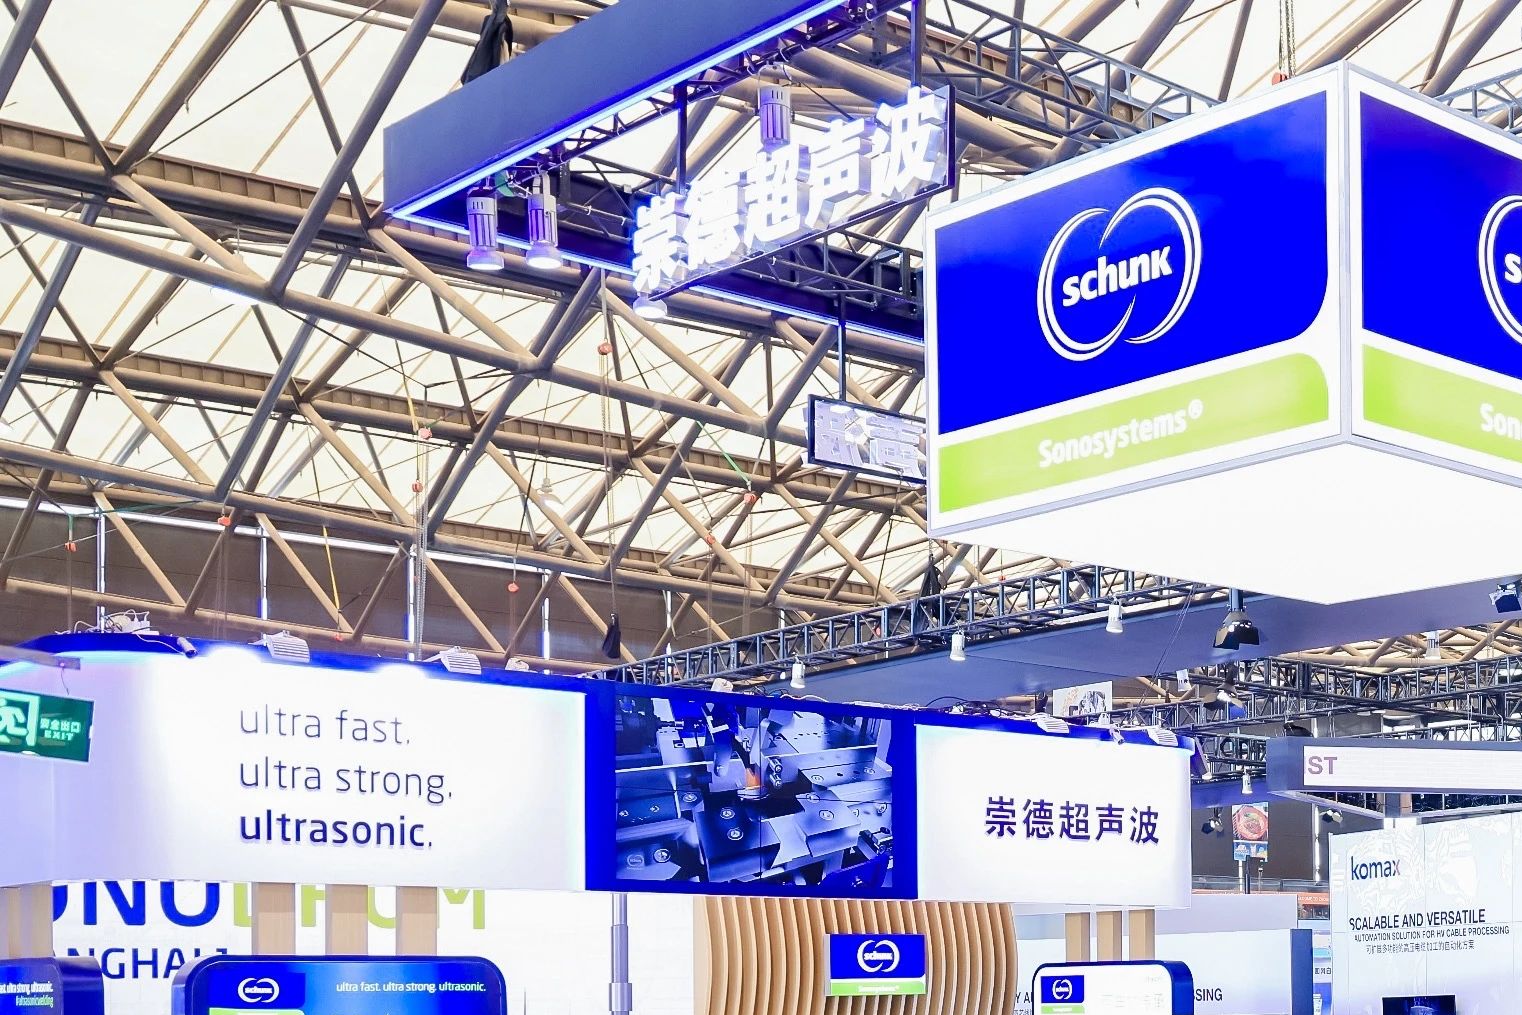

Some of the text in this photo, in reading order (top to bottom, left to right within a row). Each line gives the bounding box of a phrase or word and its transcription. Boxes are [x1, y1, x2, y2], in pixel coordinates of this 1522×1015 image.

[633, 88, 947, 292] 崇德超声波
[1062, 245, 1173, 308] schunk
[44, 730, 75, 741] EXIT
[240, 703, 411, 745] ultra fast.
[240, 756, 453, 806] ultra strong.
[239, 809, 433, 848] ultrasonic.
[984, 795, 1160, 844] 崇德超声波
[1350, 855, 1401, 881] komax
[1349, 908, 1486, 931] SCALABLE AND VERSATILE
[1422, 929, 1435, 939] FOR
[1446, 926, 1467, 937] CABLE
[1468, 924, 1510, 936] PROCESSING
[336, 981, 486, 994] ultra fast. ultra strong. ultrasonic.
